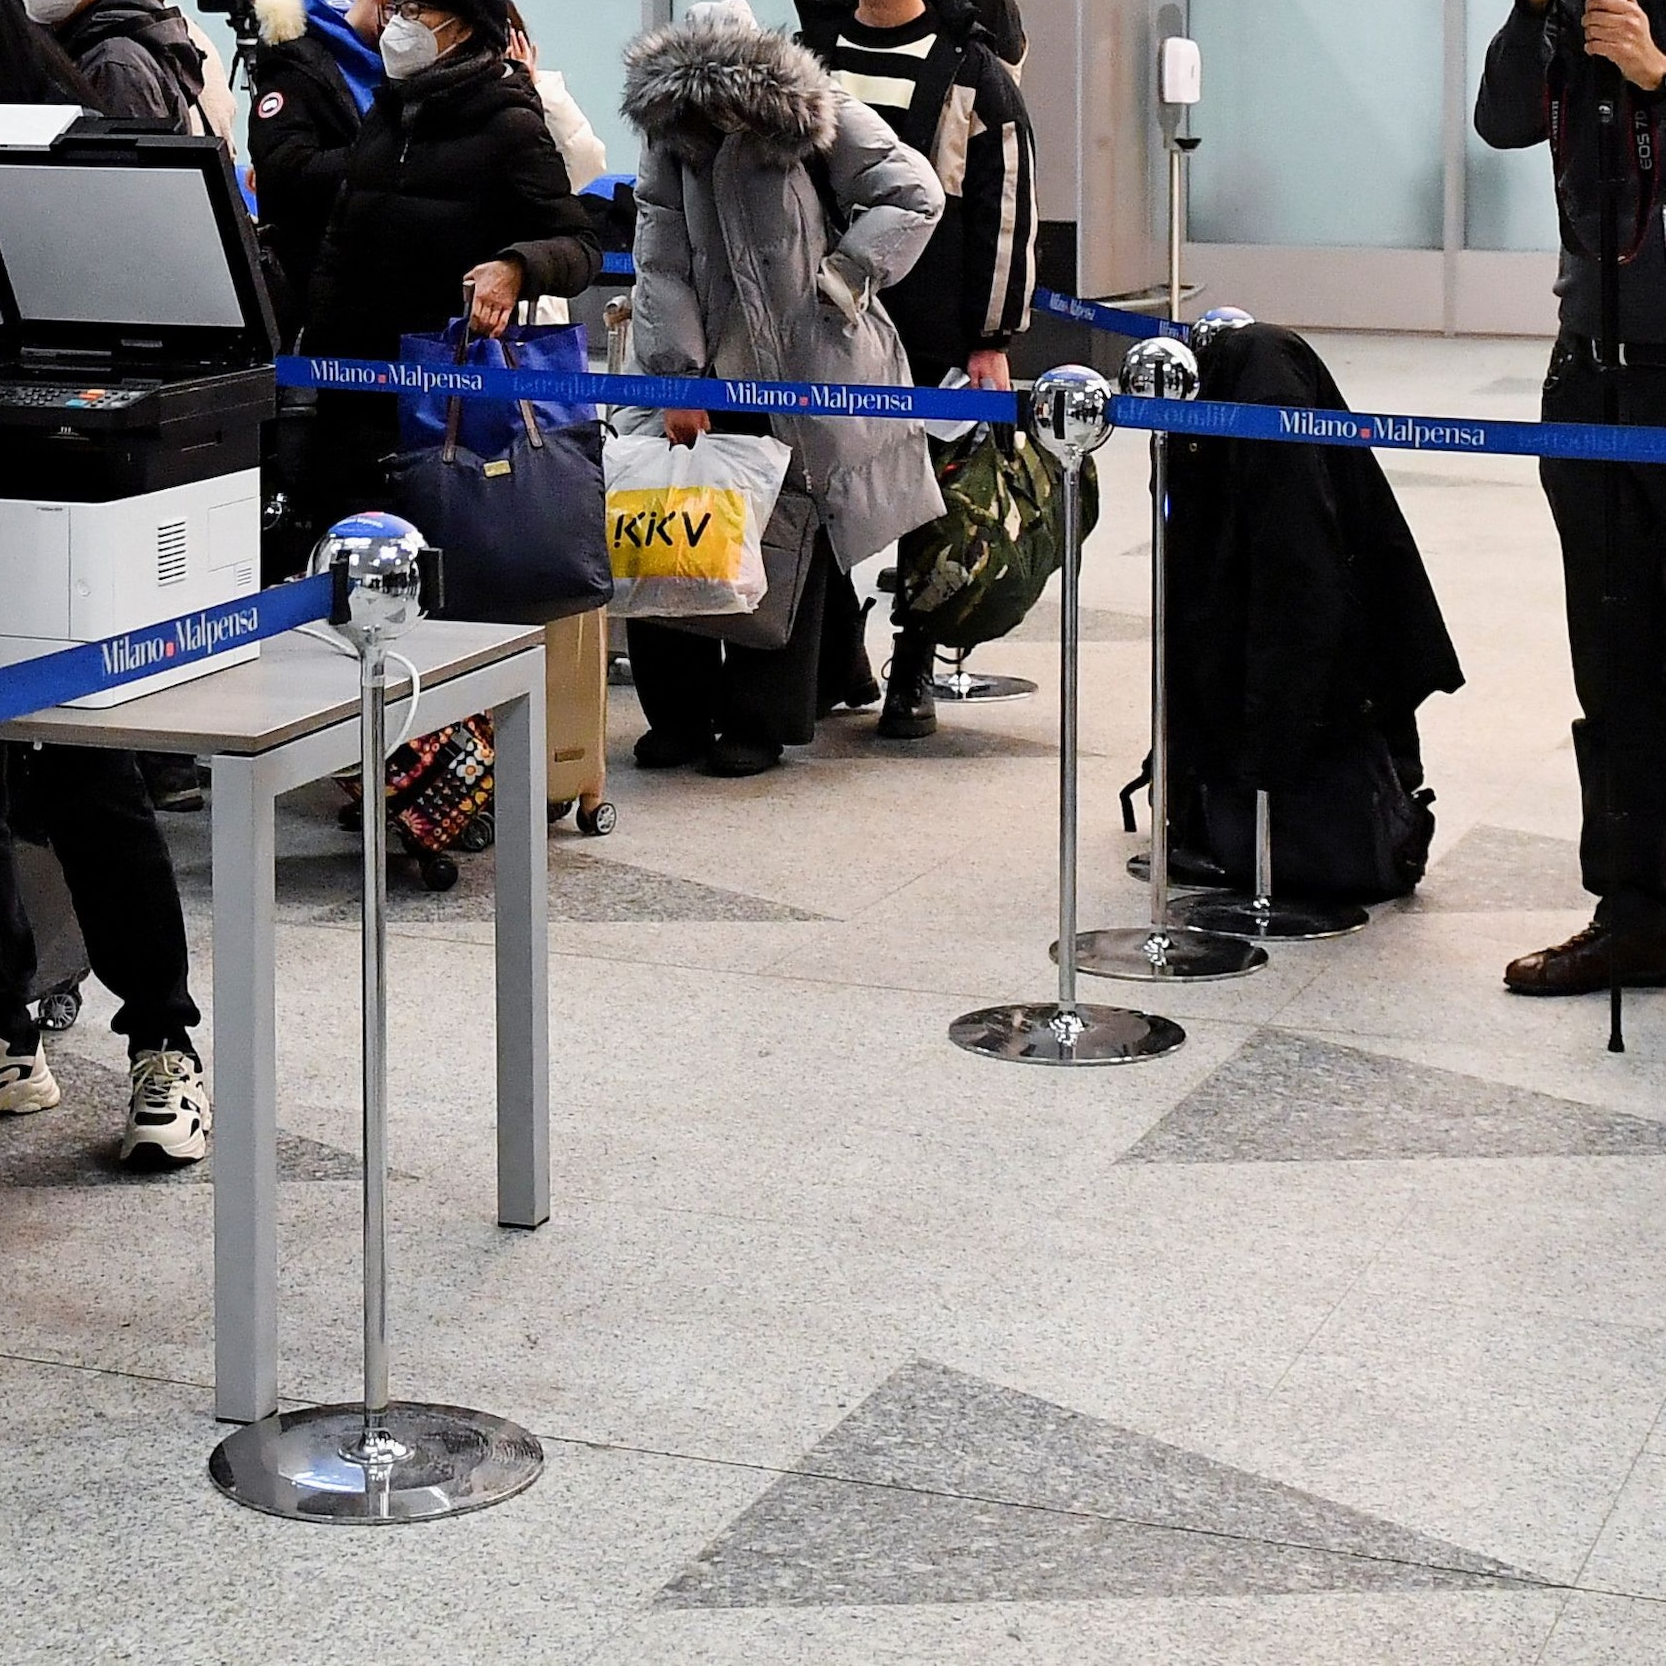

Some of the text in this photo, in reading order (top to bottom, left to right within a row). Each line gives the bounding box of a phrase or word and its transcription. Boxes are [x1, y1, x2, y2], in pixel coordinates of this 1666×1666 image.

[1636, 133, 1652, 170] EOS
[309, 358, 483, 393] Milano Malpensa
[724, 381, 914, 414] Milano Malpensa
[1278, 409, 1357, 437] Milano
[1371, 416, 1485, 448] Malpensa
[614, 511, 712, 548] KKV
[100, 605, 258, 676] Milano Malpensa
